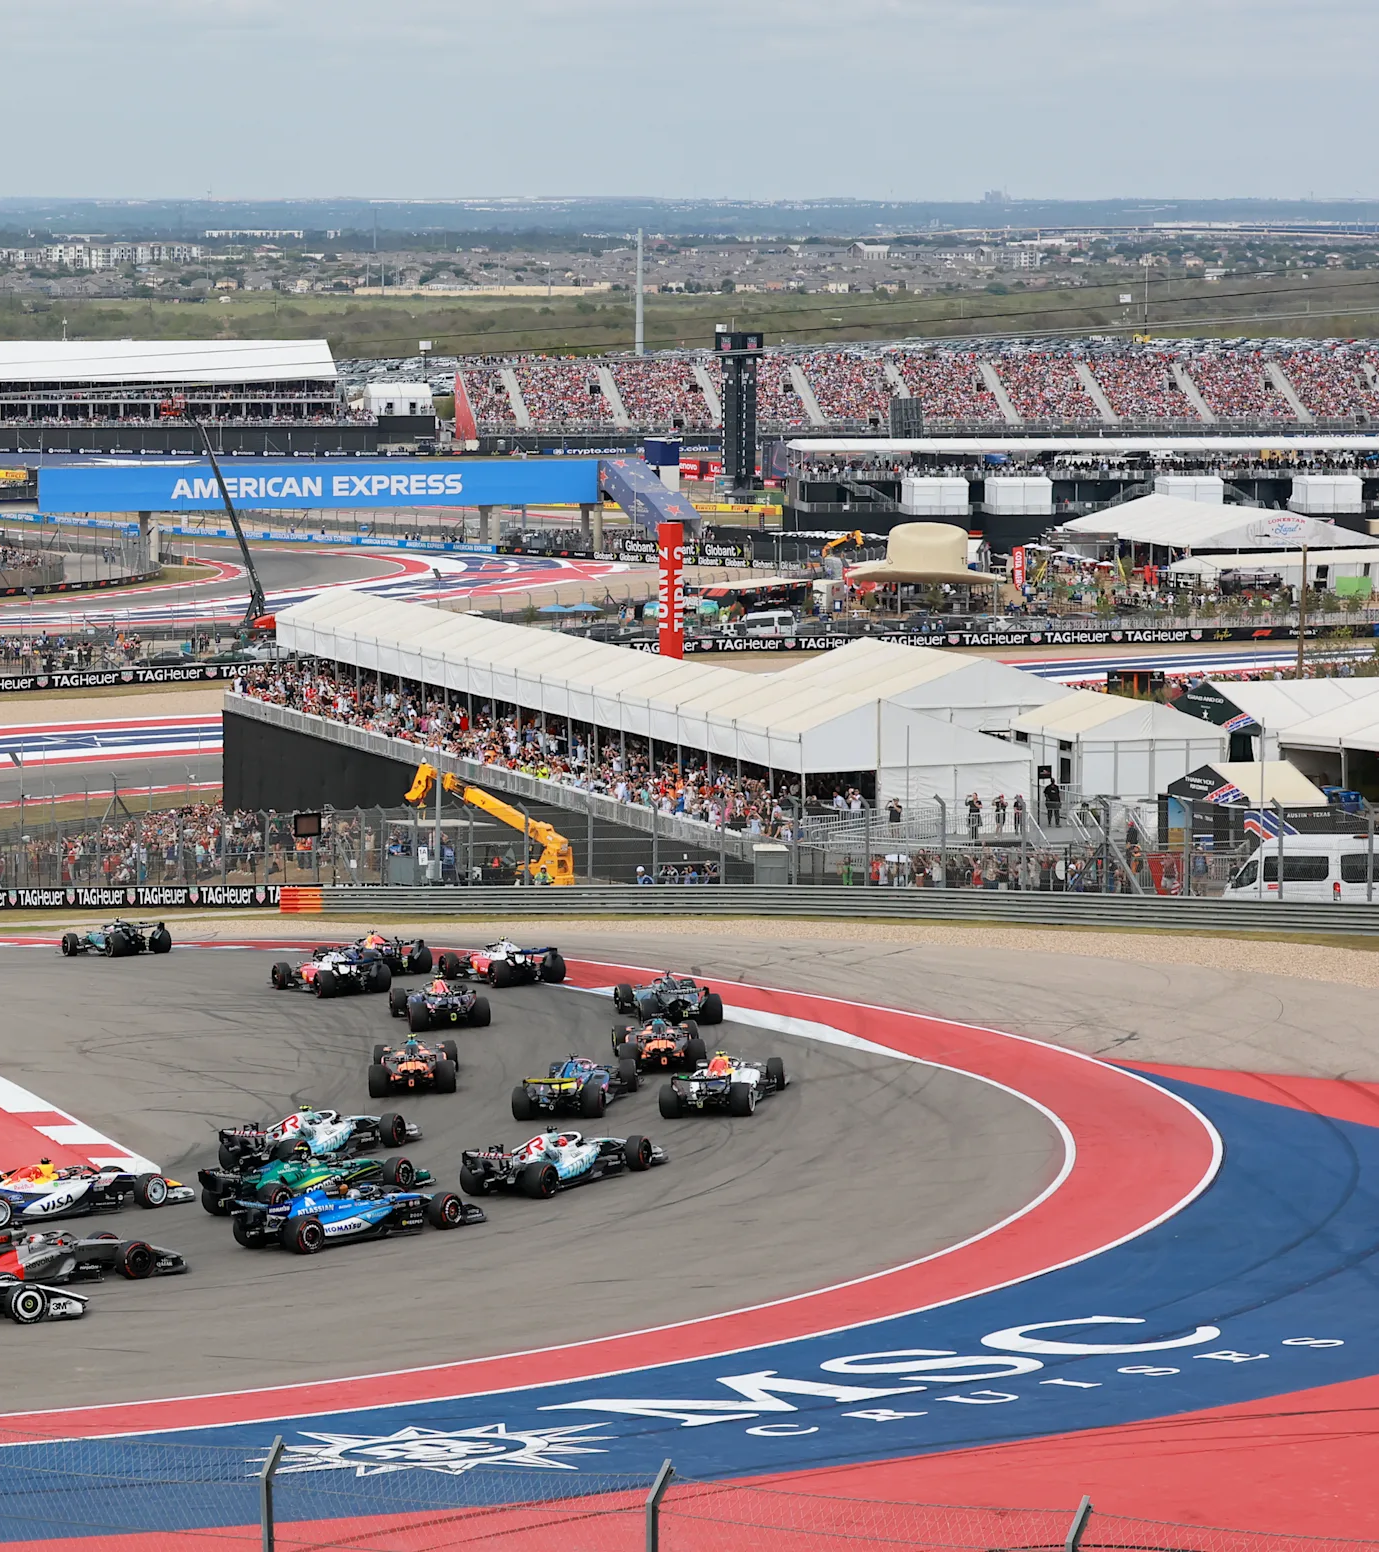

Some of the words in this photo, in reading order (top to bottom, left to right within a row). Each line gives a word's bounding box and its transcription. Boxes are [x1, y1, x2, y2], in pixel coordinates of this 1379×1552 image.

[566, 446, 626, 455] crypto.com
[680, 461, 698, 471] enovo
[170, 476, 322, 499] AMERICAN
[332, 474, 463, 497] EXPRESS
[1268, 517, 1306, 525] LONESTAR
[625, 540, 655, 553] Globant
[705, 544, 737, 557] Globant
[594, 552, 614, 561] Globant
[620, 553, 640, 562] Globant
[645, 554, 660, 562] Globa
[698, 556, 719, 565] Globant
[725, 558, 747, 567] Globant
[963, 633, 1028, 645] TAGHeuer
[1045, 631, 1109, 643] TAGHeuer
[1126, 630, 1189, 642] TAGHeuer
[716, 638, 782, 650] TAGHeuer
[52, 673, 118, 687] TAGHeuer
[136, 668, 204, 682] TAGHeuer
[1187, 694, 1203, 702] GRAB
[1185, 776, 1203, 785] THANK
[1203, 777, 1215, 786] YOU
[18, 889, 64, 906] TAGHeuer
[77, 888, 124, 905] TAGHeuer
[138, 887, 187, 904] TAGHeuer
[201, 887, 253, 904] TAGHeuer
[306, 1175, 342, 1193] aramco
[40, 1194, 74, 1212] VISA
[269, 1205, 290, 1213] KOMATSU
[297, 1204, 334, 1216] ATLASSIAN
[325, 1222, 361, 1233] KOMATSU
[25, 1254, 55, 1271] Revolut
[52, 1302, 67, 1310] 3M
[534, 1315, 1221, 1428] MSC
[746, 1336, 1345, 1436] CRUISES
